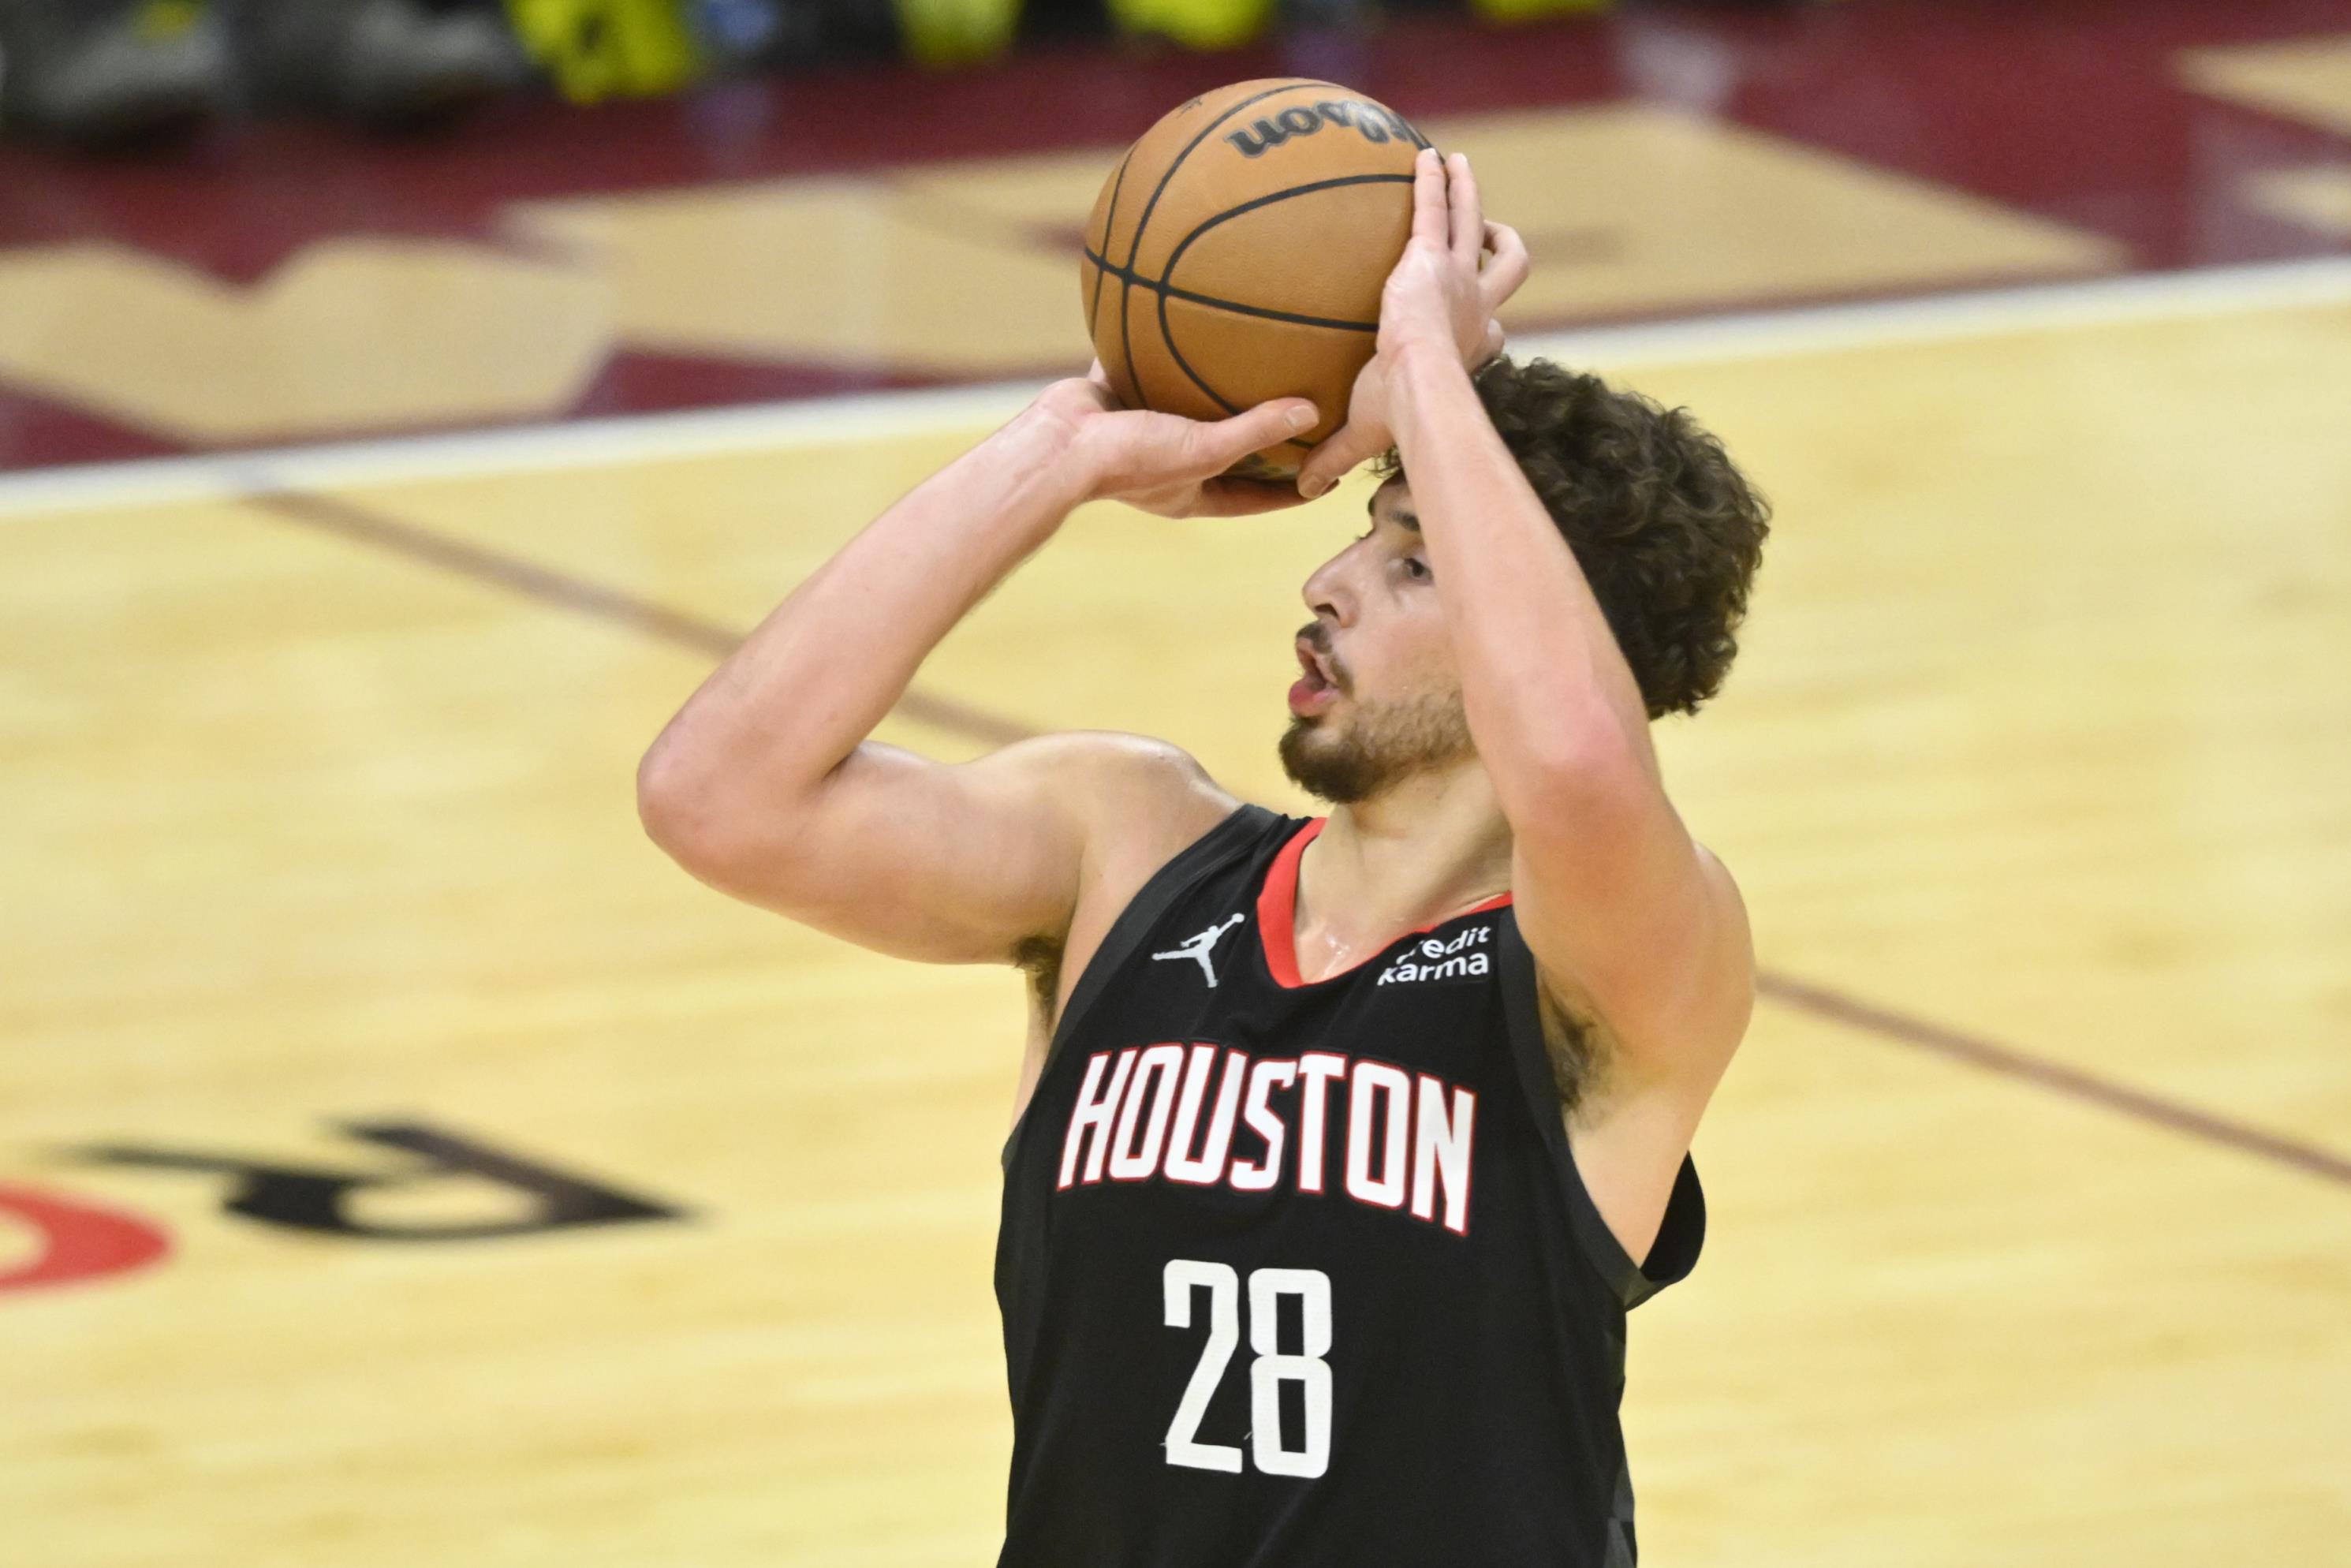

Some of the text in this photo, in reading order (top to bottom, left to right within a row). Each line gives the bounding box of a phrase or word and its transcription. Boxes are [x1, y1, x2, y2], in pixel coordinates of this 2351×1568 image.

[1223, 99, 1442, 159] ilson
[1057, 1042, 1477, 1236] HOUSTON
[1163, 1259, 1333, 1479] 28
